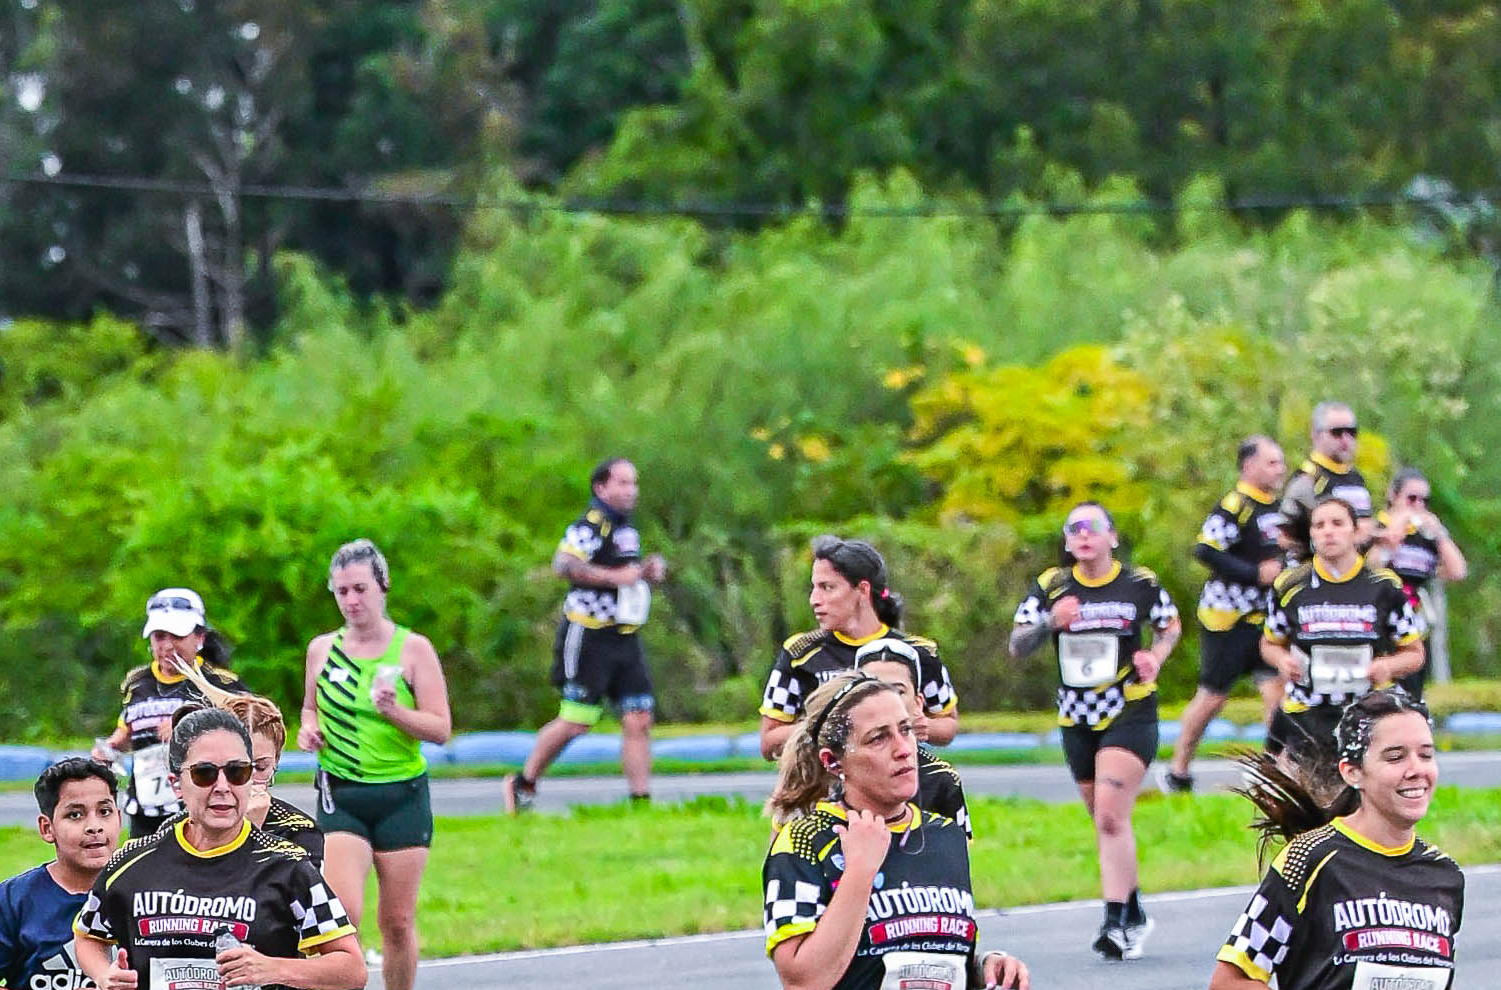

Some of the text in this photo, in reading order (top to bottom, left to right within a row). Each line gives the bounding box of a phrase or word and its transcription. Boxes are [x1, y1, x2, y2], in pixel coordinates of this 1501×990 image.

[1082, 663, 1092, 677] 6
[133, 888, 257, 922] AUTÓDROMO
[1333, 891, 1451, 938] AUTÓDROMO
[149, 917, 199, 934] RUNNING
[885, 917, 969, 940] RUNNING RACE
[1358, 932, 1441, 953] RUNNING RACE
